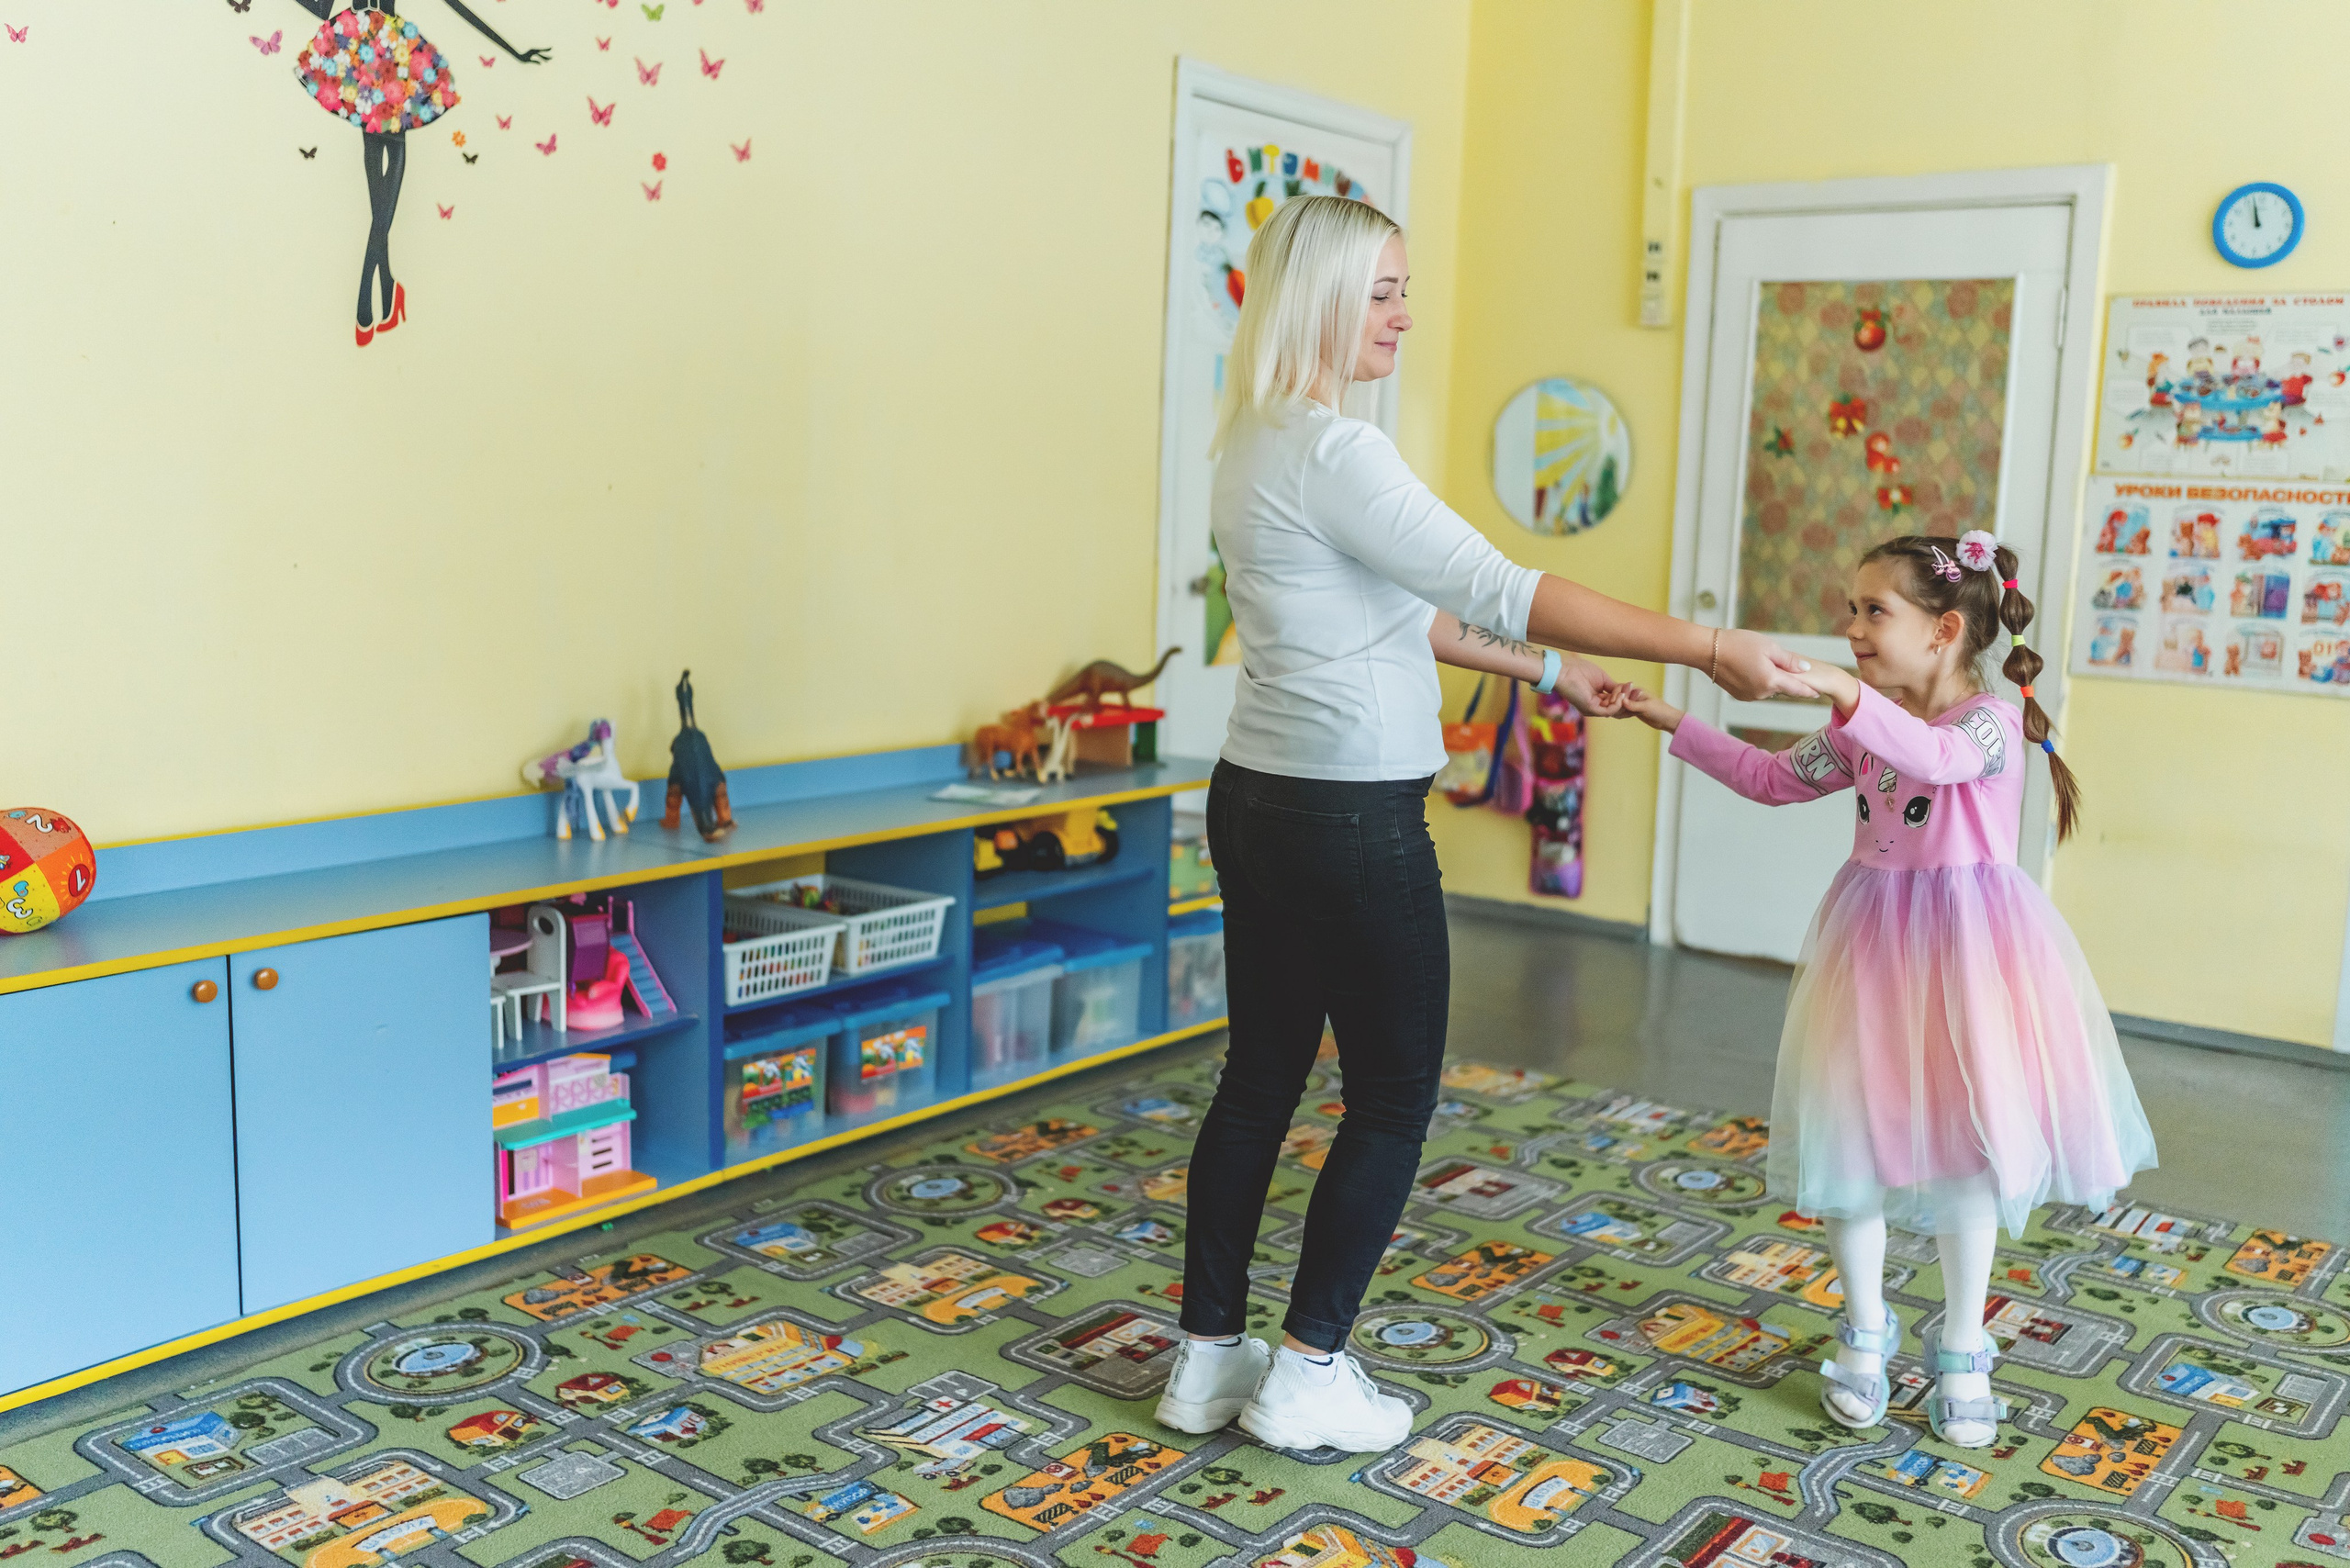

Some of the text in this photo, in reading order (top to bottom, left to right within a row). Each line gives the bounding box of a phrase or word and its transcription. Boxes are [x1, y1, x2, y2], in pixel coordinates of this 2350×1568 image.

[2115, 483, 2182, 498] УРОКИ
[1798, 737, 1836, 781] RN
[26, 813, 53, 834] 2
[75, 868, 86, 892] 1
[6, 898, 34, 919] 3
